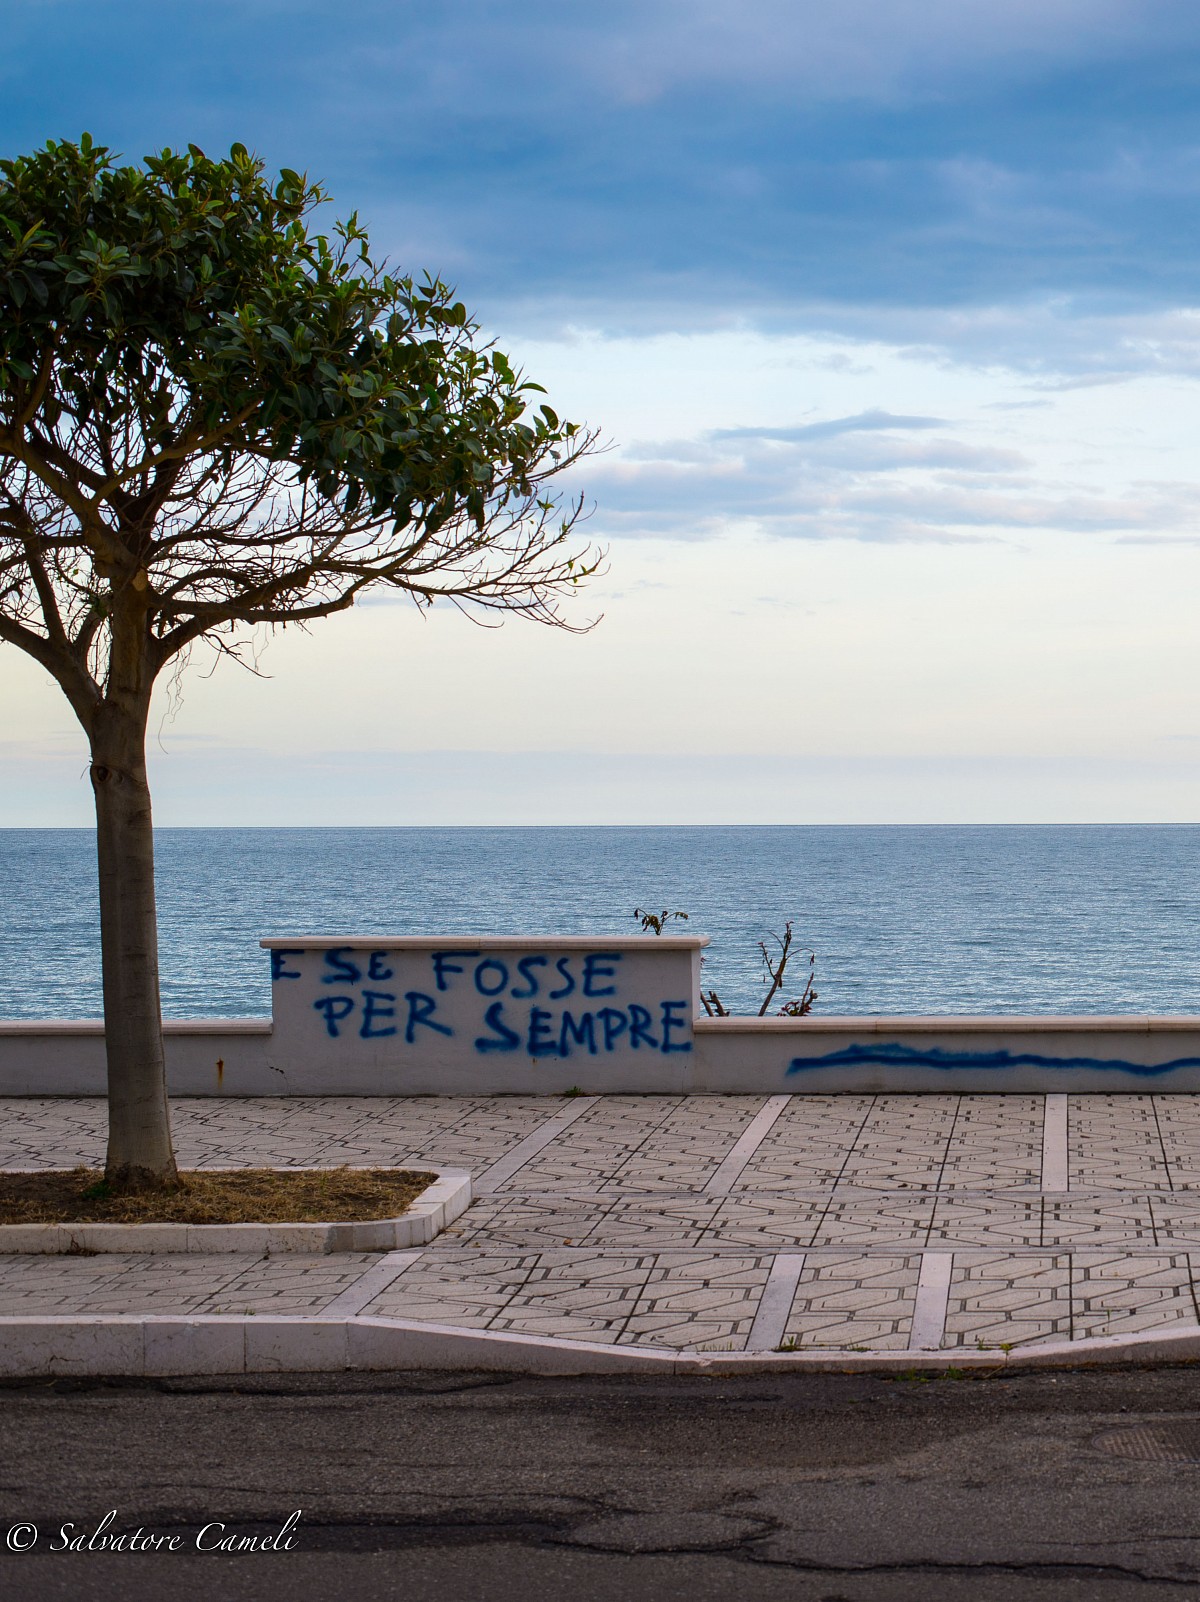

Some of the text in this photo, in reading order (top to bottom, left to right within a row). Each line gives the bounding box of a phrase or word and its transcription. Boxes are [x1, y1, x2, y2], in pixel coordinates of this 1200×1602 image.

[271, 946, 625, 1000] E SE FOSSE
[313, 990, 692, 1058] PER SEMPRE
